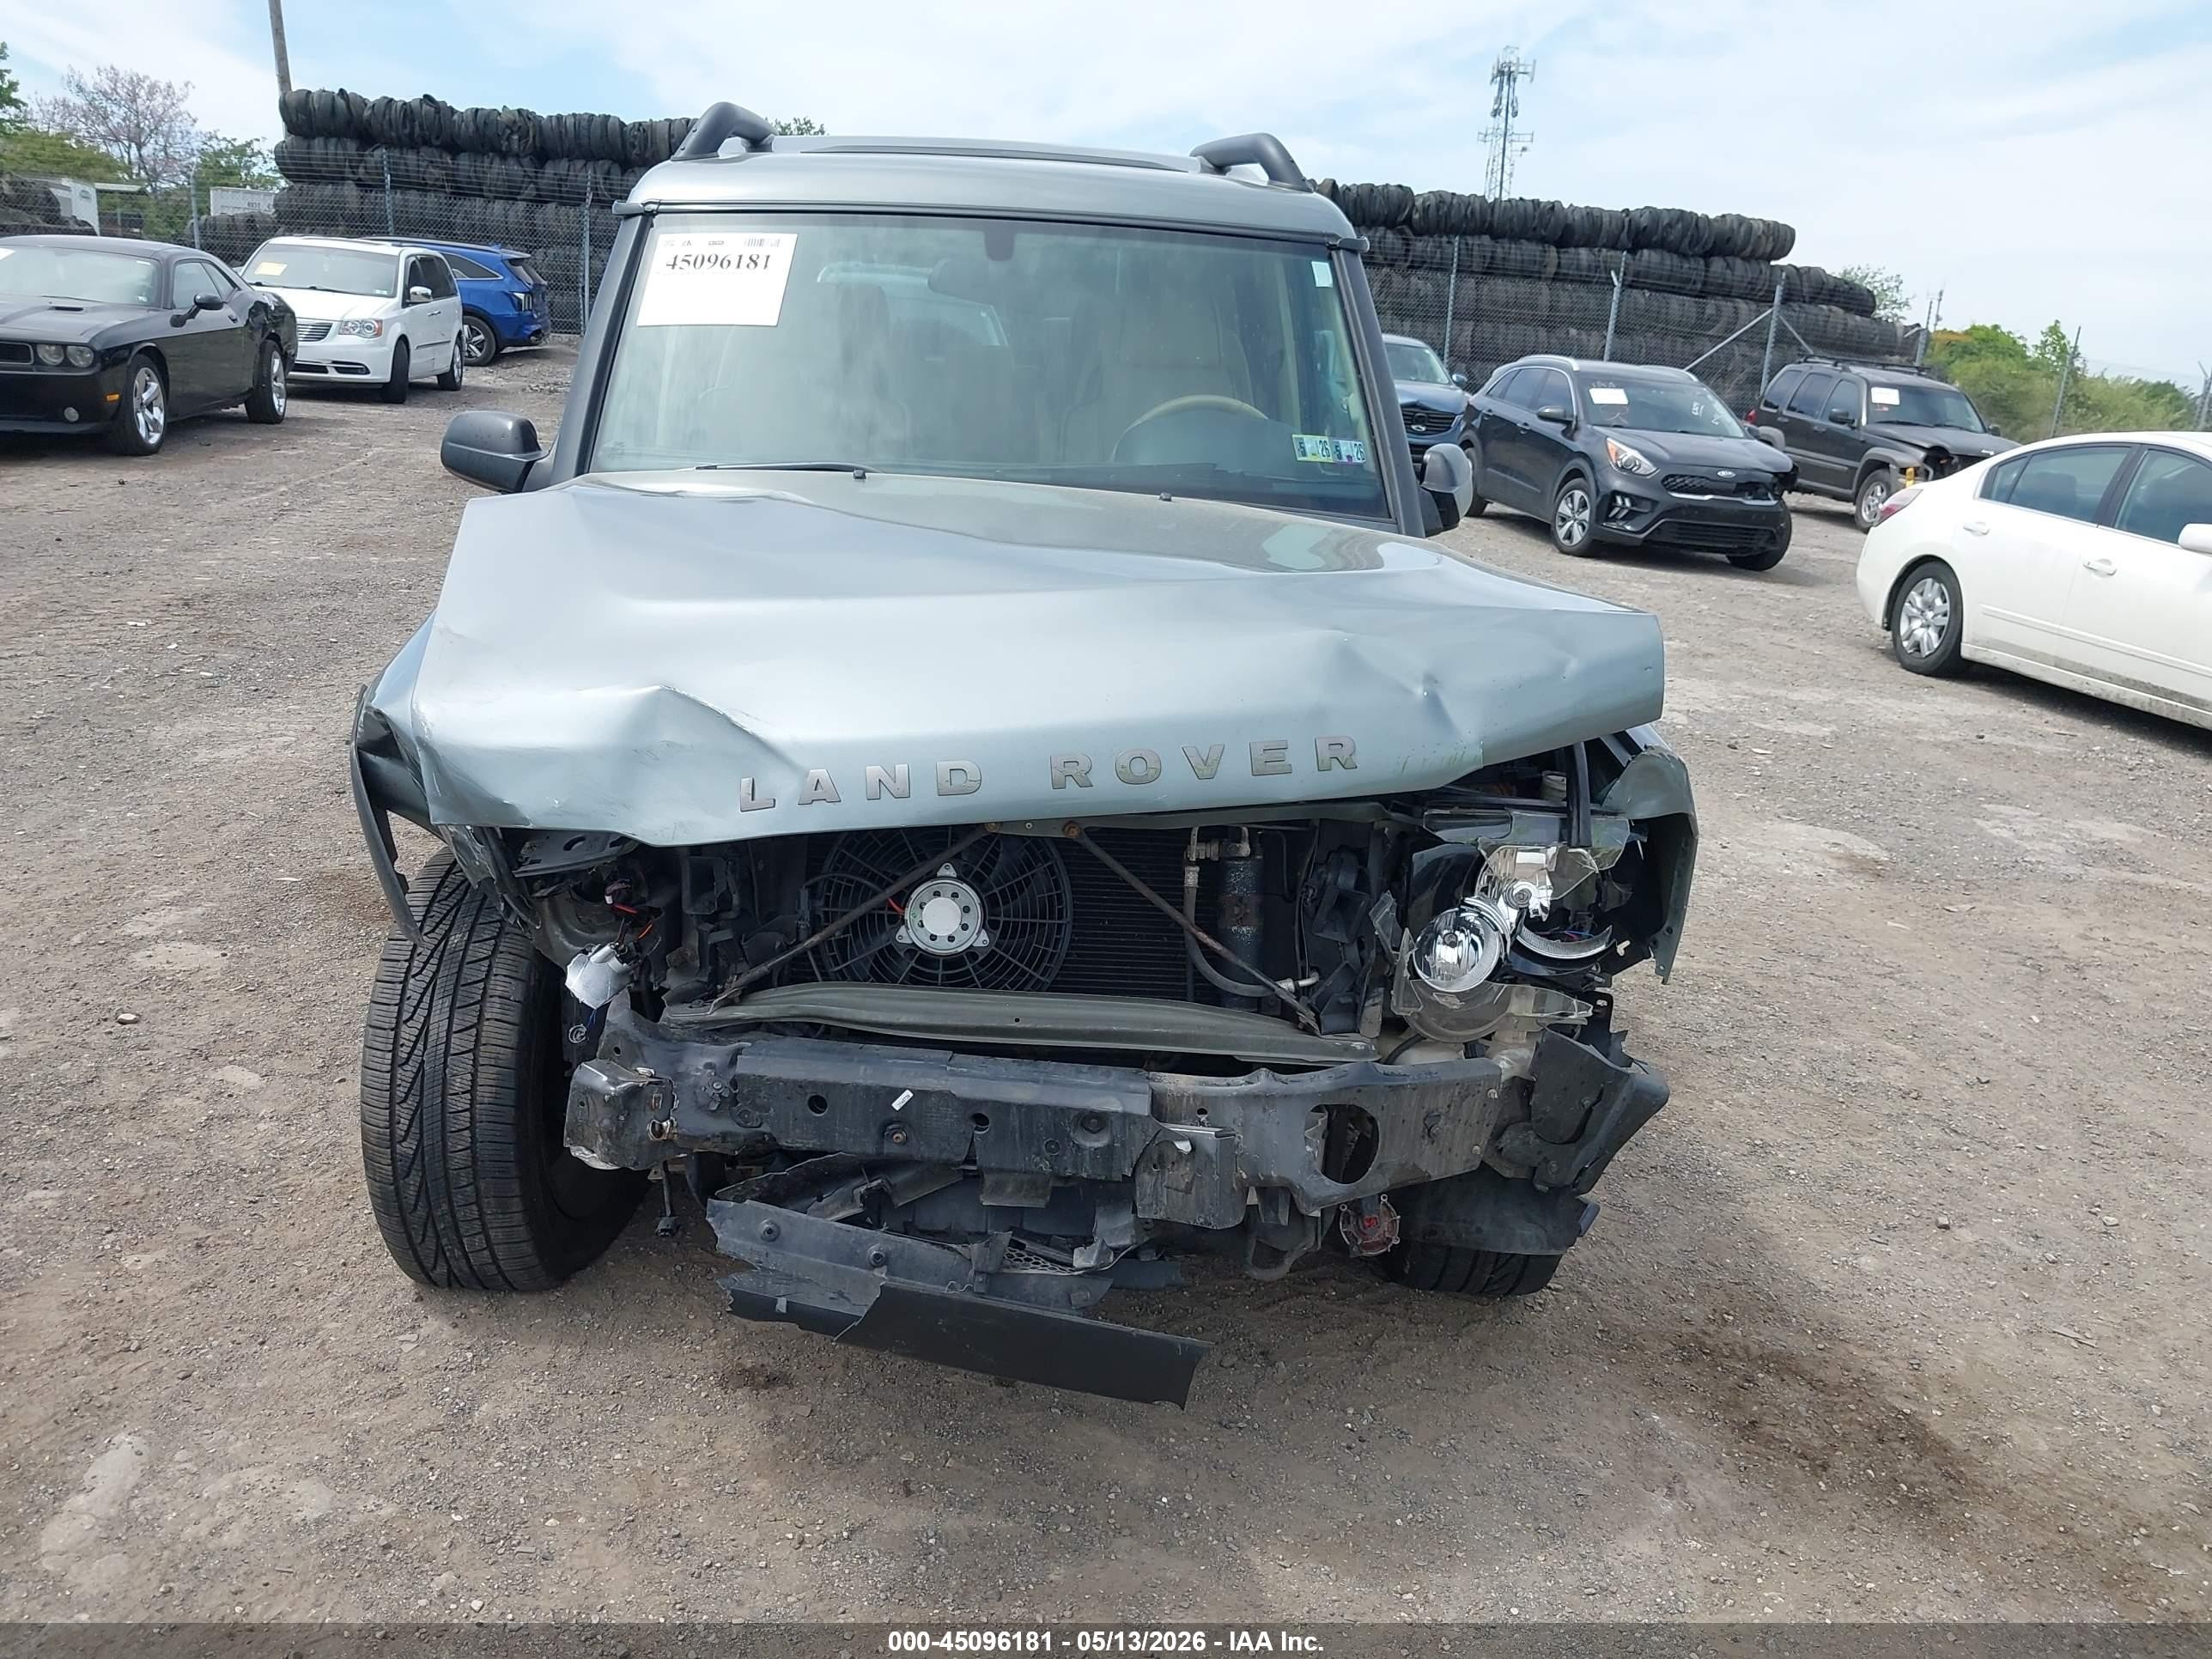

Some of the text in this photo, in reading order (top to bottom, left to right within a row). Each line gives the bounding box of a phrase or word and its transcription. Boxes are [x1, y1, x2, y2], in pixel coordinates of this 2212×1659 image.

[666, 253, 771, 270] 45096181
[1318, 440, 1331, 458] 26
[1353, 443, 1366, 461] 26
[738, 735, 1358, 811] LAND ROVER
